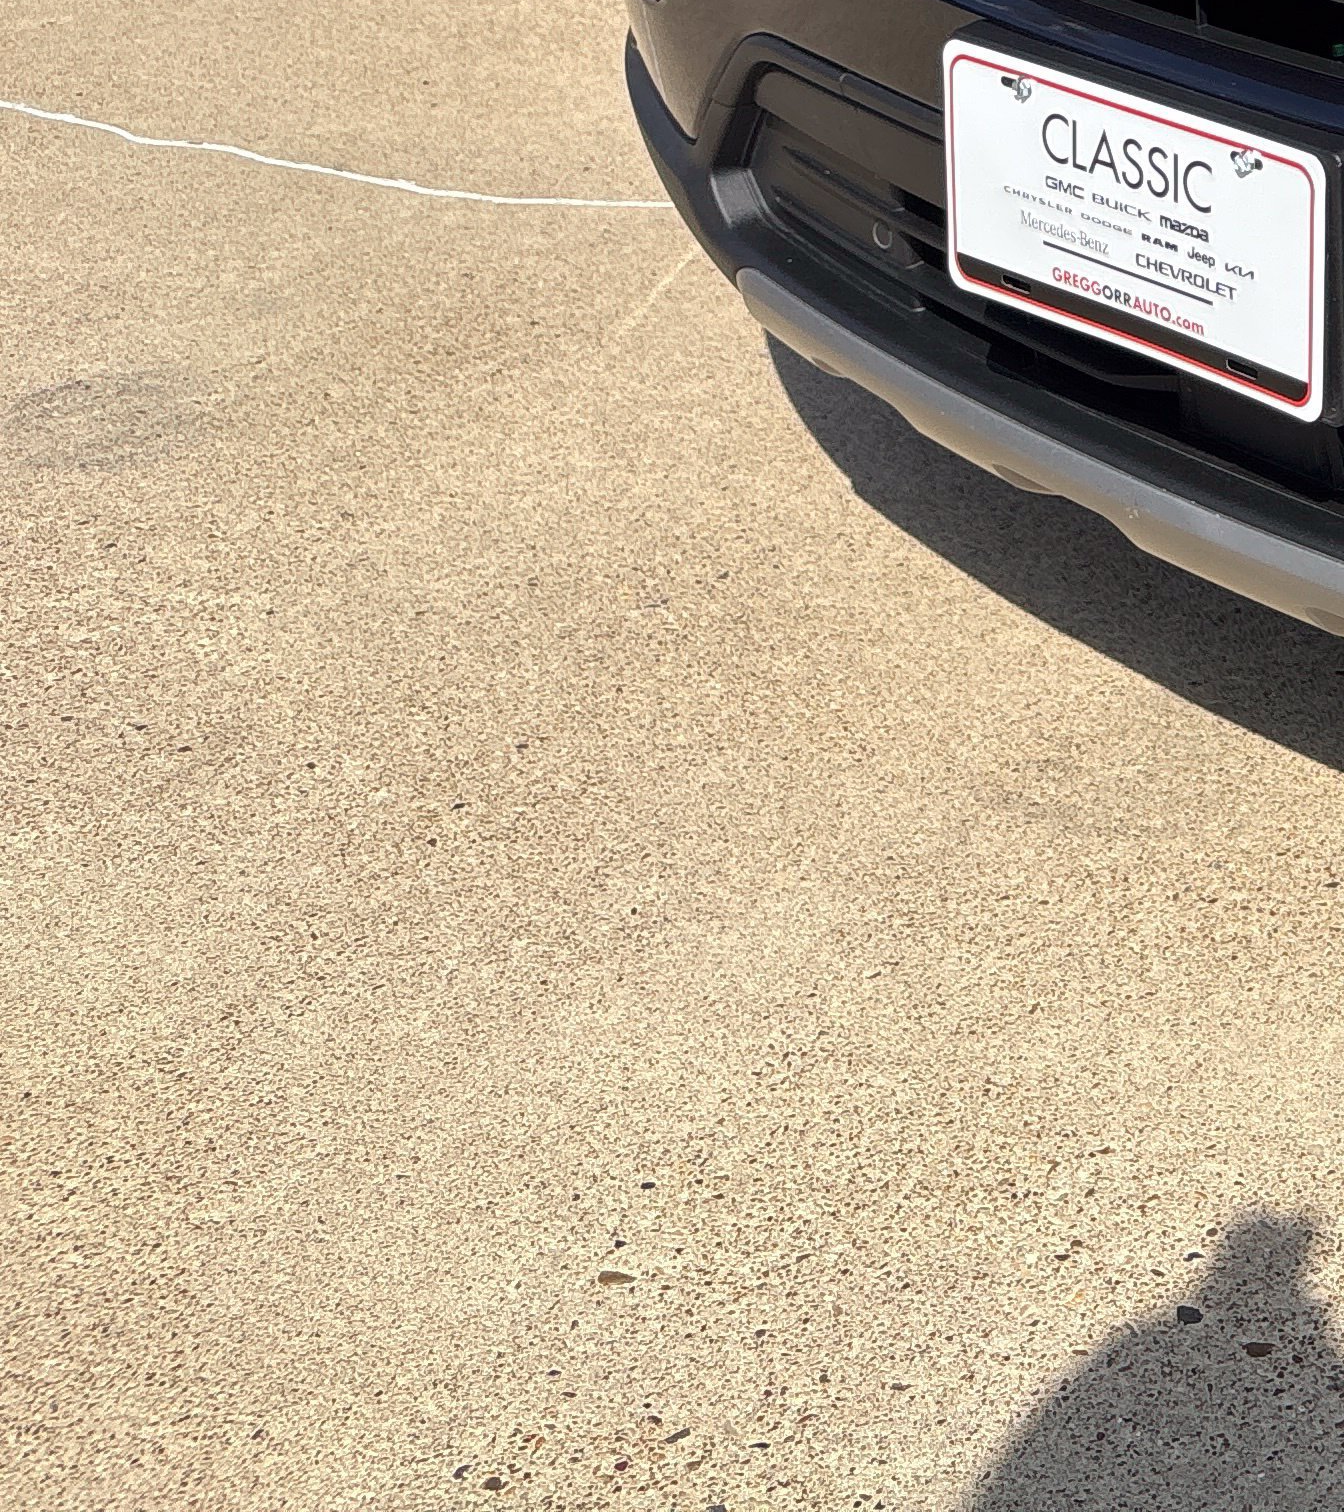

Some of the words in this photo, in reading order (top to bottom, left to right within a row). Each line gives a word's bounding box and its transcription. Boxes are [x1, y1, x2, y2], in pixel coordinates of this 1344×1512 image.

[1042, 113, 1213, 214] CLASSIC
[1045, 175, 1085, 200] GMC
[1092, 192, 1152, 222] BUICK
[1003, 185, 1073, 215] CHRYSLER
[1080, 212, 1133, 236] DODGE
[1141, 232, 1179, 252] RAM
[1187, 246, 1216, 268] Jeep
[1020, 209, 1110, 256] Mercedes-Benz
[1135, 252, 1238, 301] CHEVROLET
[1052, 266, 1205, 336] GREGGORRAUTO.com
